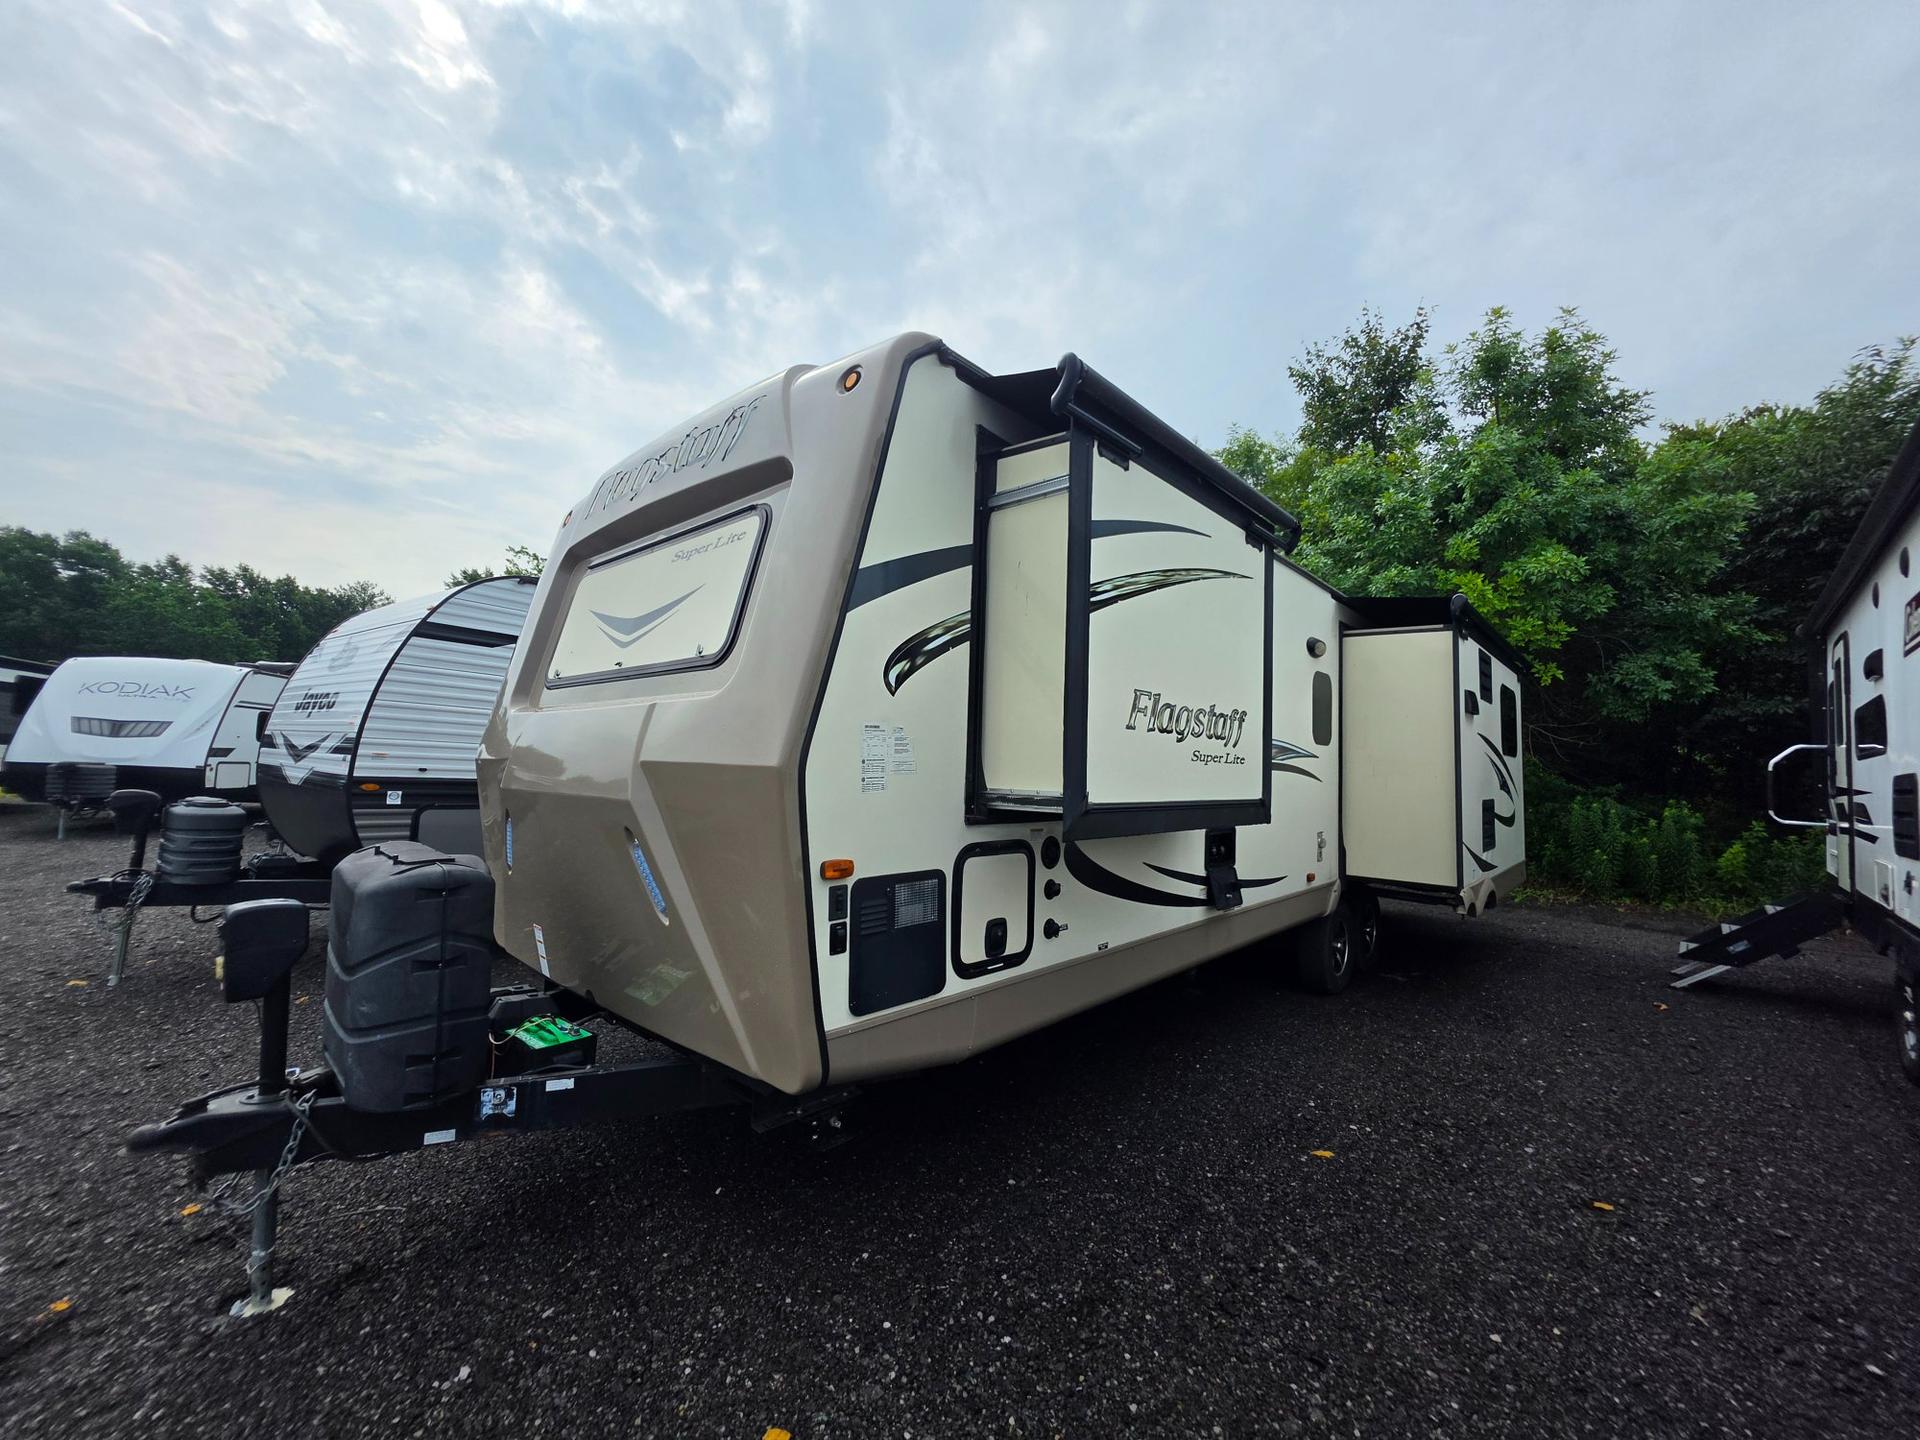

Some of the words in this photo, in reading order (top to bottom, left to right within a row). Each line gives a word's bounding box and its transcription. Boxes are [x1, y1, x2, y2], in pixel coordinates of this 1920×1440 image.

[584, 394, 768, 520] Flagstaff
[671, 542, 713, 563] Super
[713, 531, 747, 549] Lite
[78, 681, 196, 699] KODIAK
[1125, 688, 1248, 748] Flagstaff
[1190, 750, 1223, 766] Super
[1224, 752, 1246, 765] Lite
